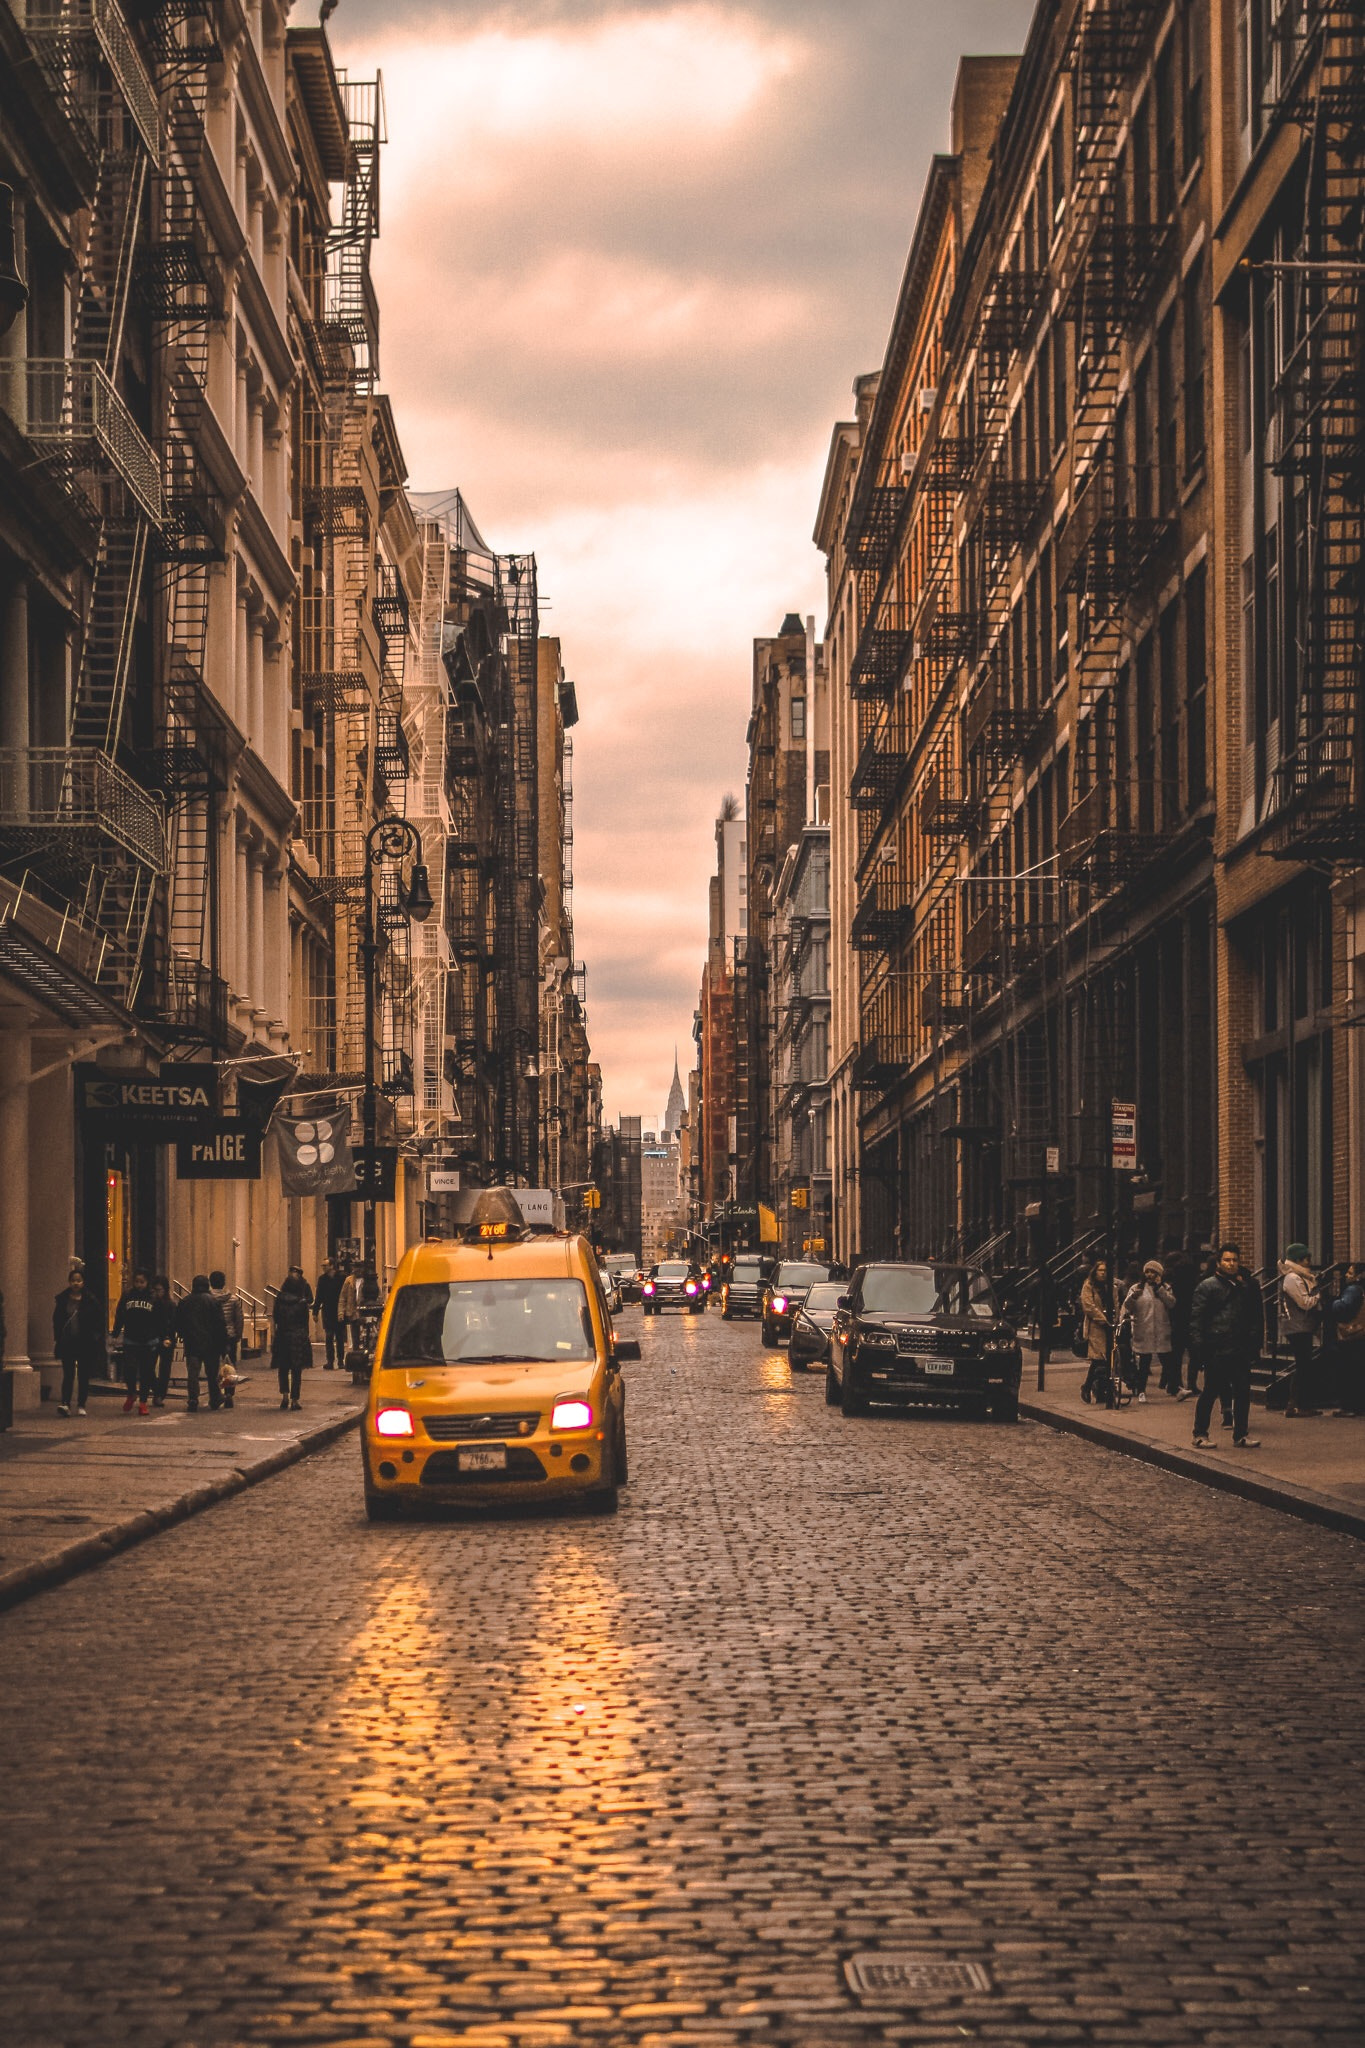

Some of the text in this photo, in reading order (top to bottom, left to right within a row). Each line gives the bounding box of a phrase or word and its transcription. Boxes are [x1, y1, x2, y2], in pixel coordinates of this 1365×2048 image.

[121, 1084, 209, 1107] KEETSA
[191, 1134, 246, 1161] PAIGE
[527, 1203, 548, 1211] LANG
